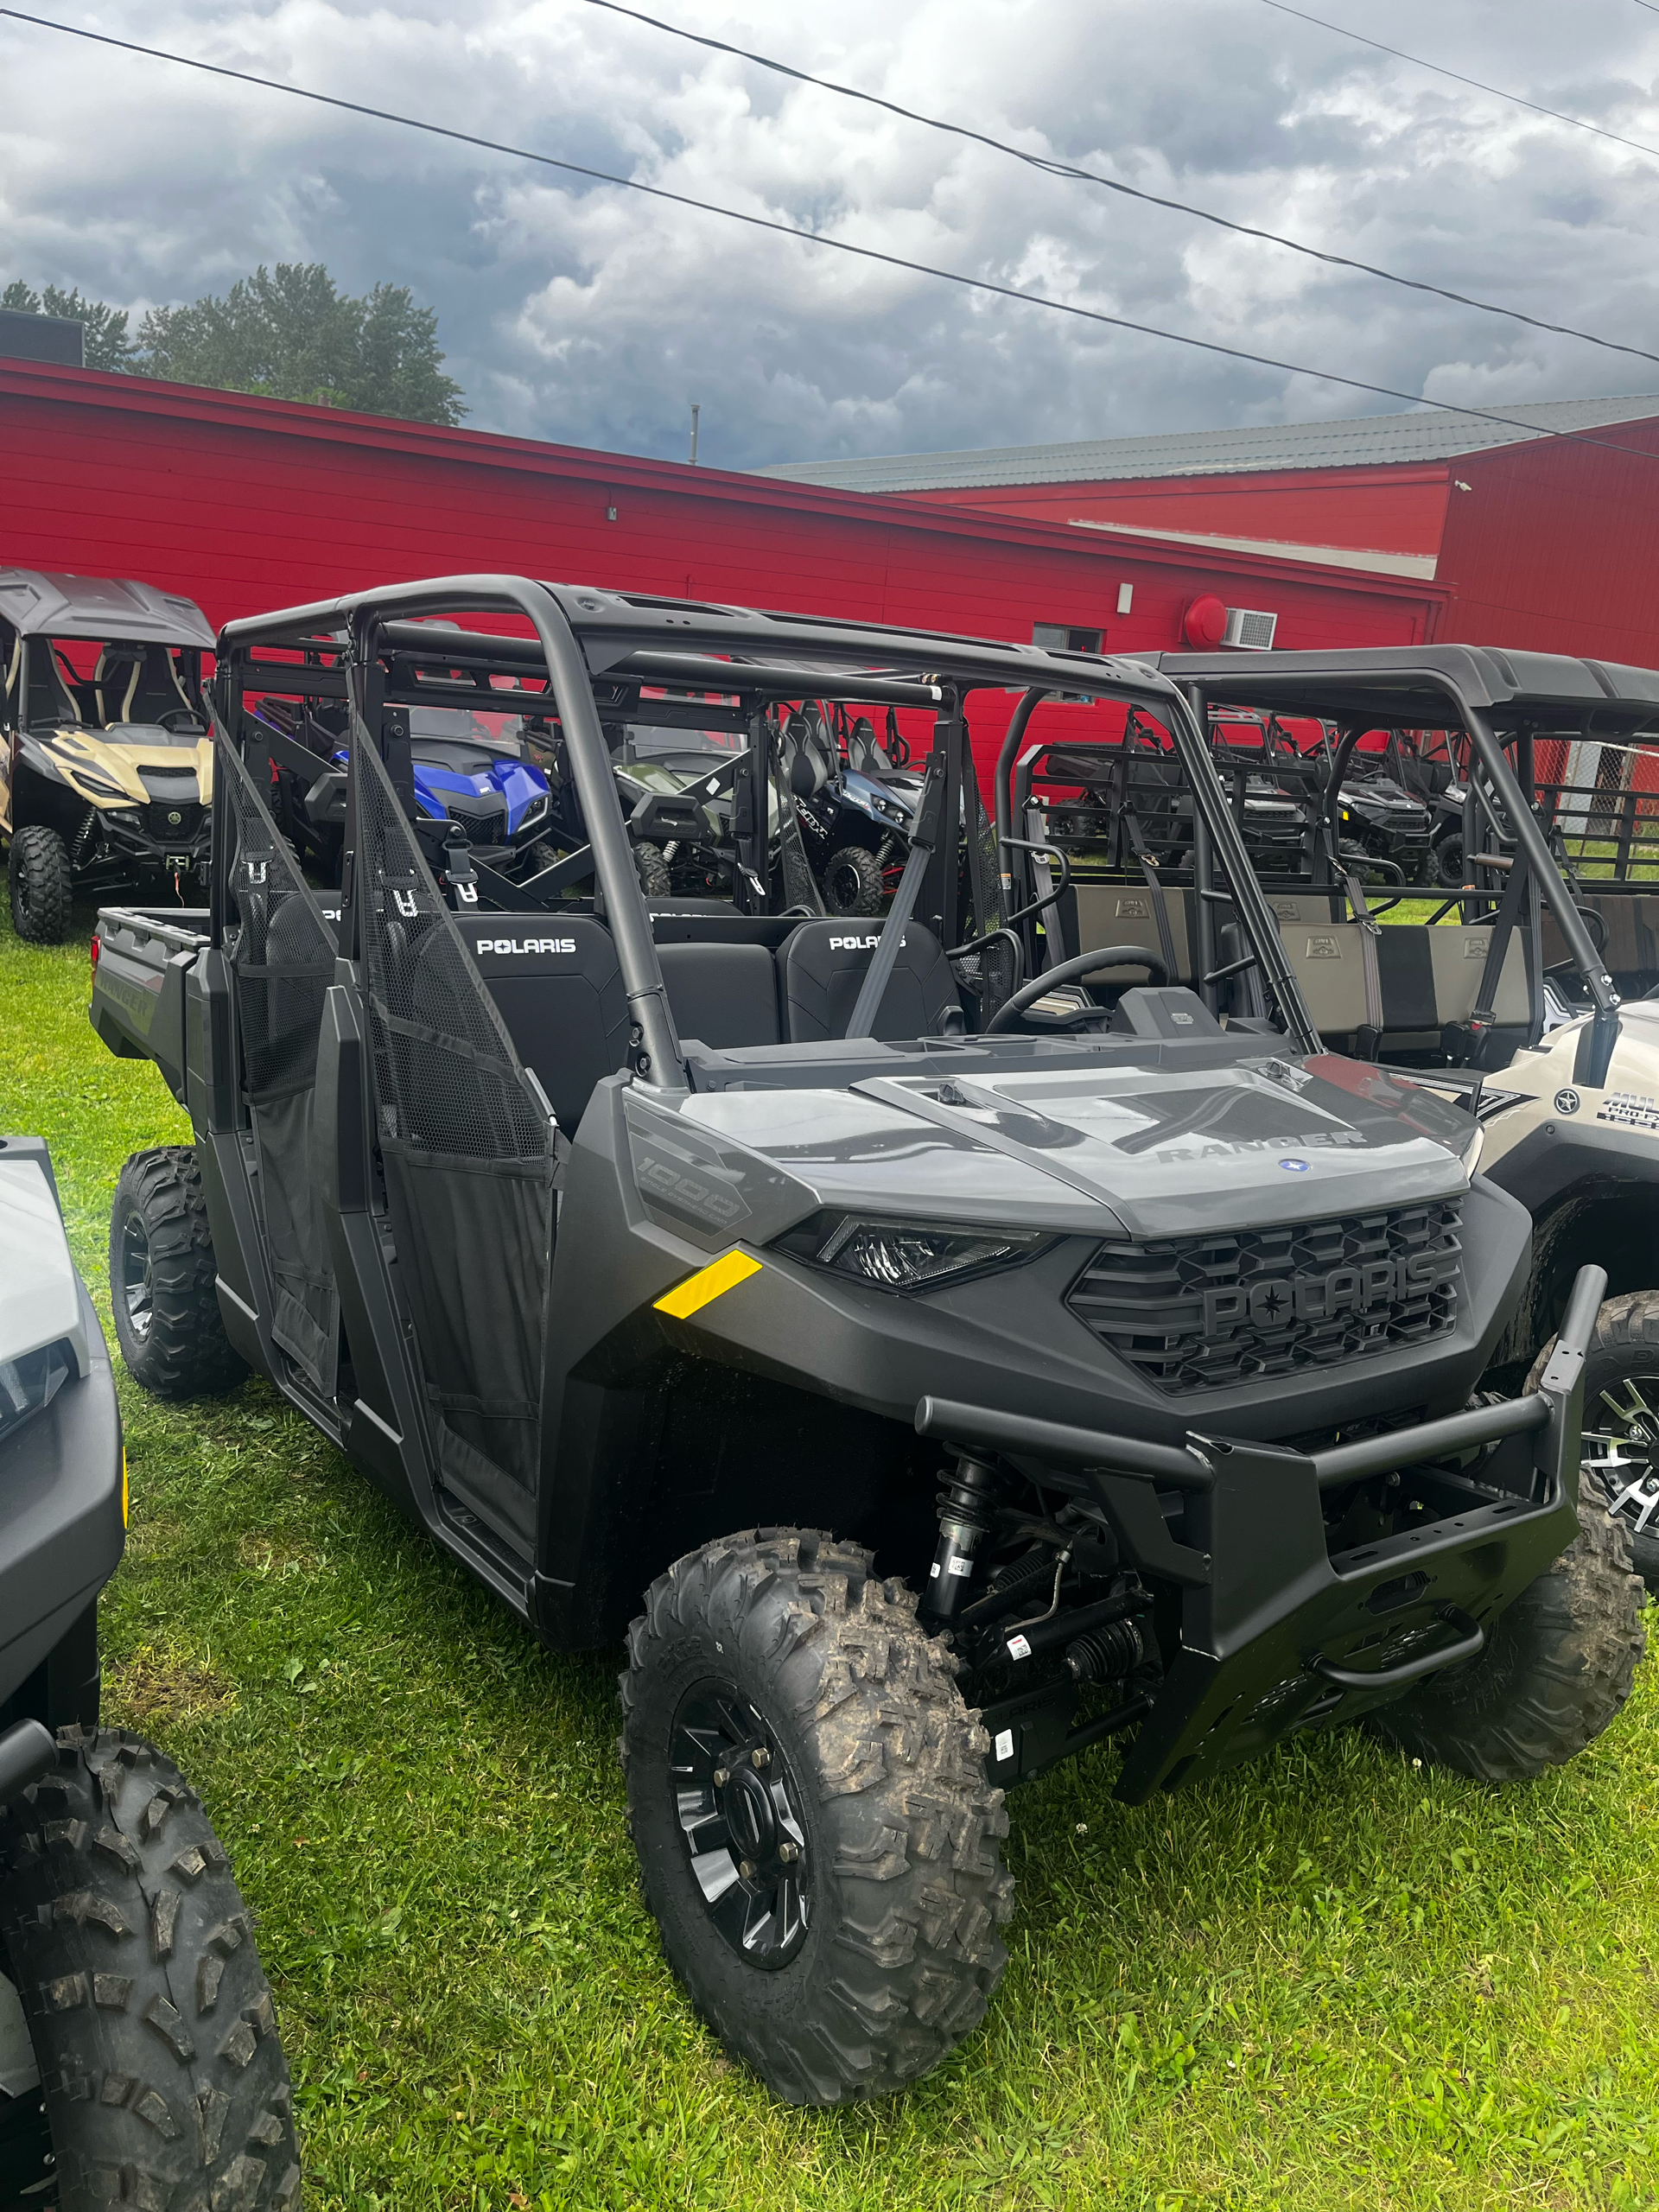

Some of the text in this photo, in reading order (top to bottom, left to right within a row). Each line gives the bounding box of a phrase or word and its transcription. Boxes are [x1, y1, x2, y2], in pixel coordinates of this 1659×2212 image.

[476, 938, 576, 955] POLARIS
[830, 935, 906, 950] POLAS
[1156, 1130, 1368, 1164] RANGER
[638, 1157, 741, 1217] 1000
[640, 1177, 728, 1225] SINGLE OVERHEAD CAM
[1204, 1250, 1438, 1337] POLARIS
